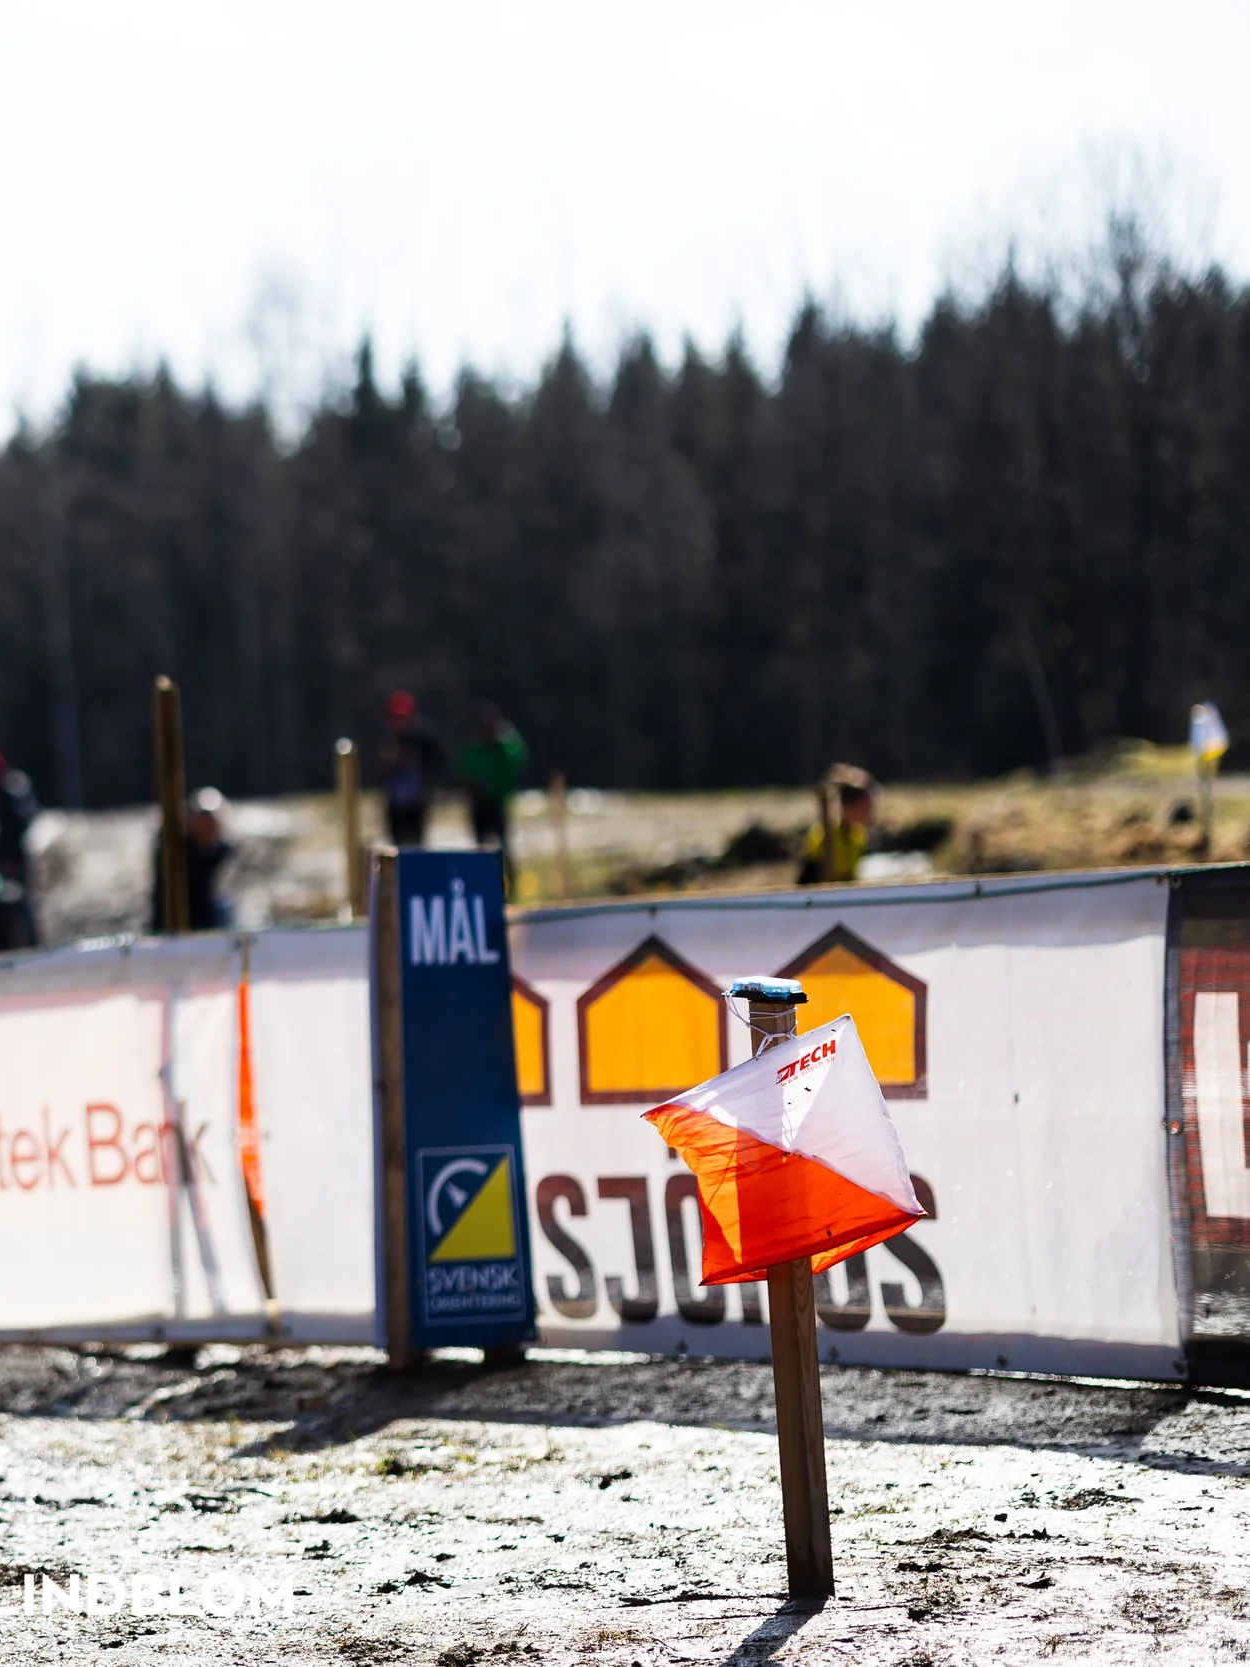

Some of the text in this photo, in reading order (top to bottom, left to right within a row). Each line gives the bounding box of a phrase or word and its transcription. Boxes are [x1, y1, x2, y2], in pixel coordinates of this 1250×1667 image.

[409, 878, 499, 967] MÅL
[86, 1100, 216, 1187] Bank
[428, 1263, 519, 1293] SVENSK
